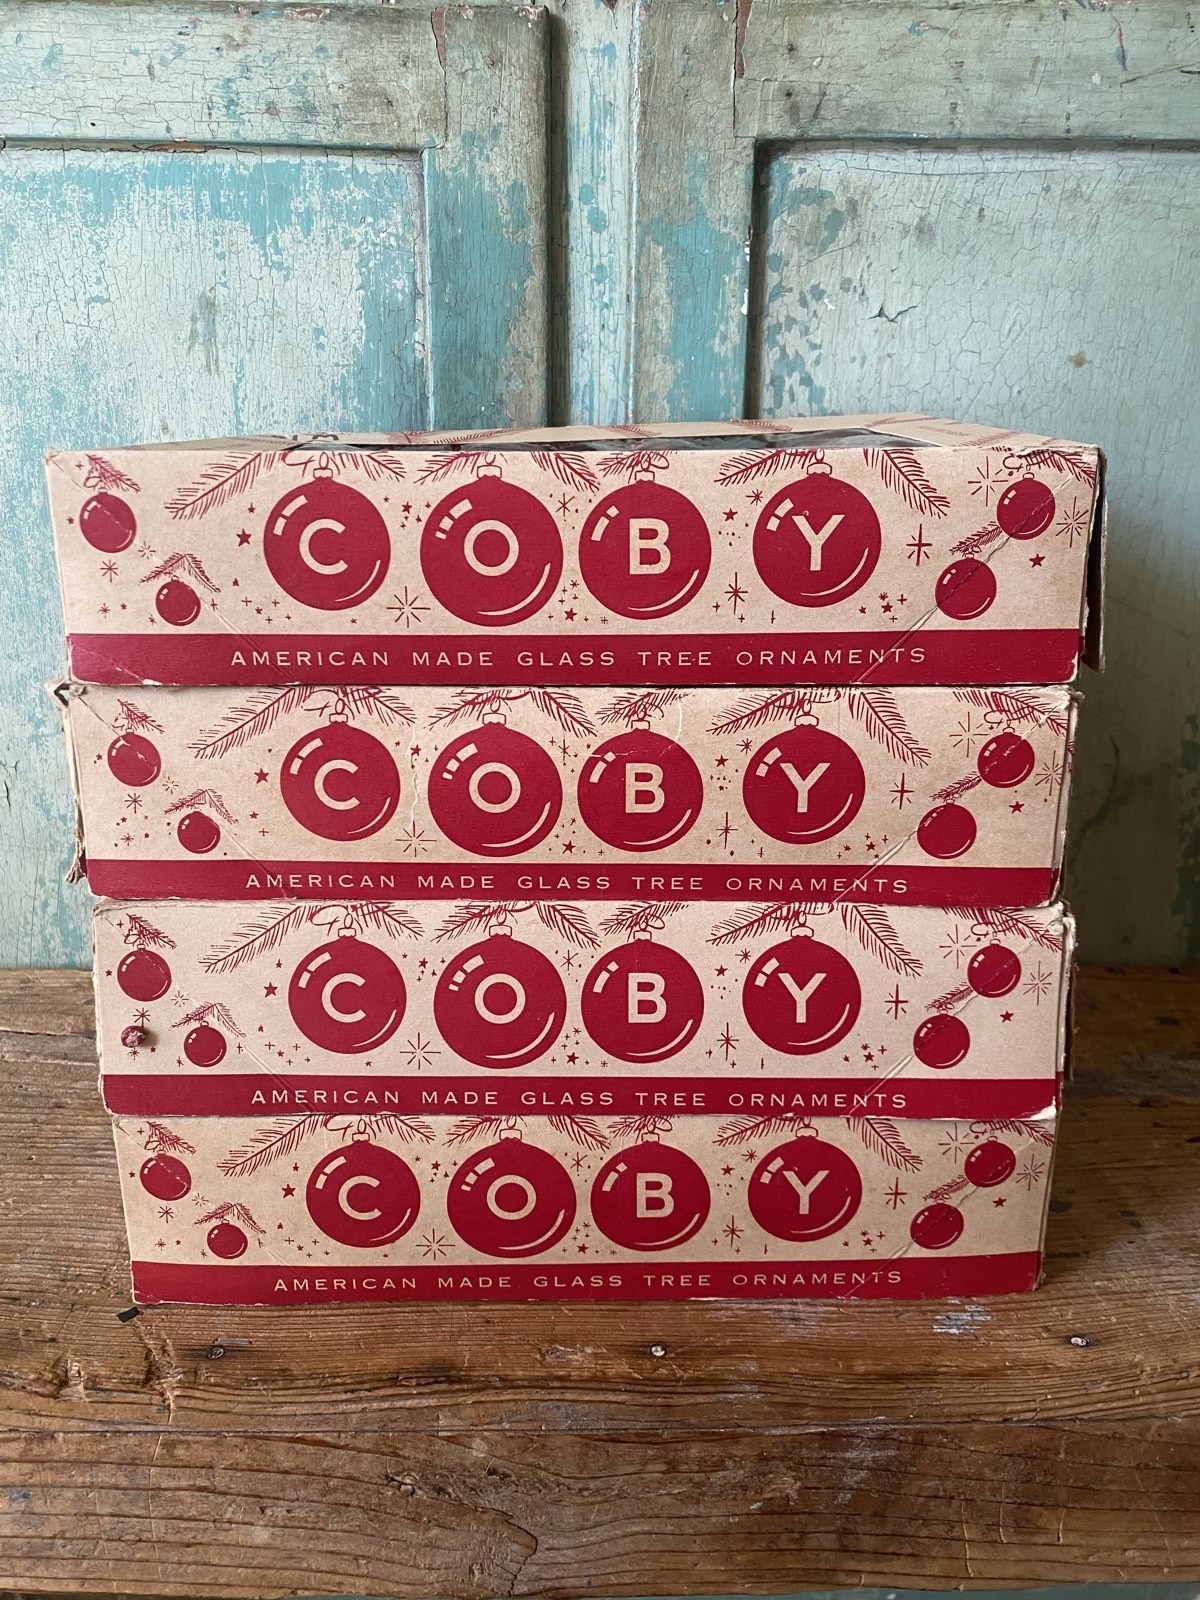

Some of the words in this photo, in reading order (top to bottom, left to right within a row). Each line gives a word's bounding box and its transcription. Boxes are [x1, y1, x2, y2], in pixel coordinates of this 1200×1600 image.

[298, 514, 846, 577] COBY
[230, 650, 389, 667] AMERICAN
[412, 651, 494, 667] MADE
[517, 651, 616, 667] GLASS
[637, 650, 713, 666] TREE
[736, 647, 926, 666] ORNAMENTS
[313, 759, 831, 814] COBY
[245, 874, 395, 890] AMERICAN
[417, 875, 495, 890] MADE
[517, 875, 611, 890] GLASS
[631, 876, 703, 890] TREE
[725, 877, 908, 893] ORNAMENTS
[321, 972, 827, 1025] COBY
[251, 1089, 400, 1106] AMERICAN
[422, 1091, 499, 1106] MADE
[520, 1091, 614, 1106] GLASS
[634, 1092, 706, 1106] TREE
[728, 1093, 907, 1108] ORNAMENTS
[338, 1170, 830, 1221] COBY
[273, 1278, 417, 1292] AMERICAN
[437, 1276, 512, 1289] MADE
[533, 1275, 623, 1287] GLASS
[642, 1274, 711, 1287] TREE
[732, 1270, 902, 1286] ORNAMENTS
